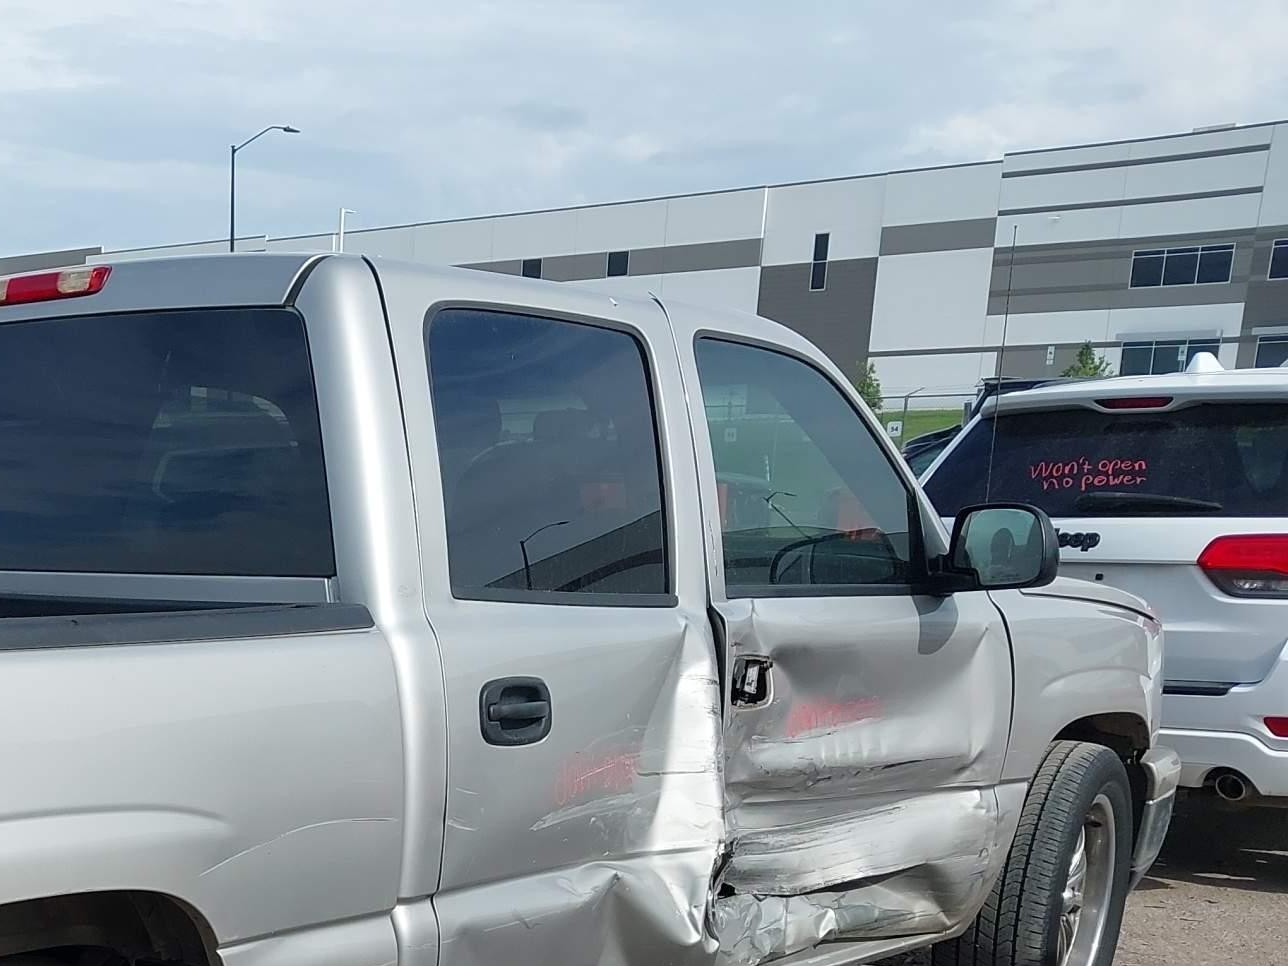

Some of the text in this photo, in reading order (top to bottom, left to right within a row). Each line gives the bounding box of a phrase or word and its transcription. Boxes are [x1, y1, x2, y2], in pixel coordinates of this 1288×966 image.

[1098, 460, 1146, 475] open
[1043, 475, 1147, 491] no power
